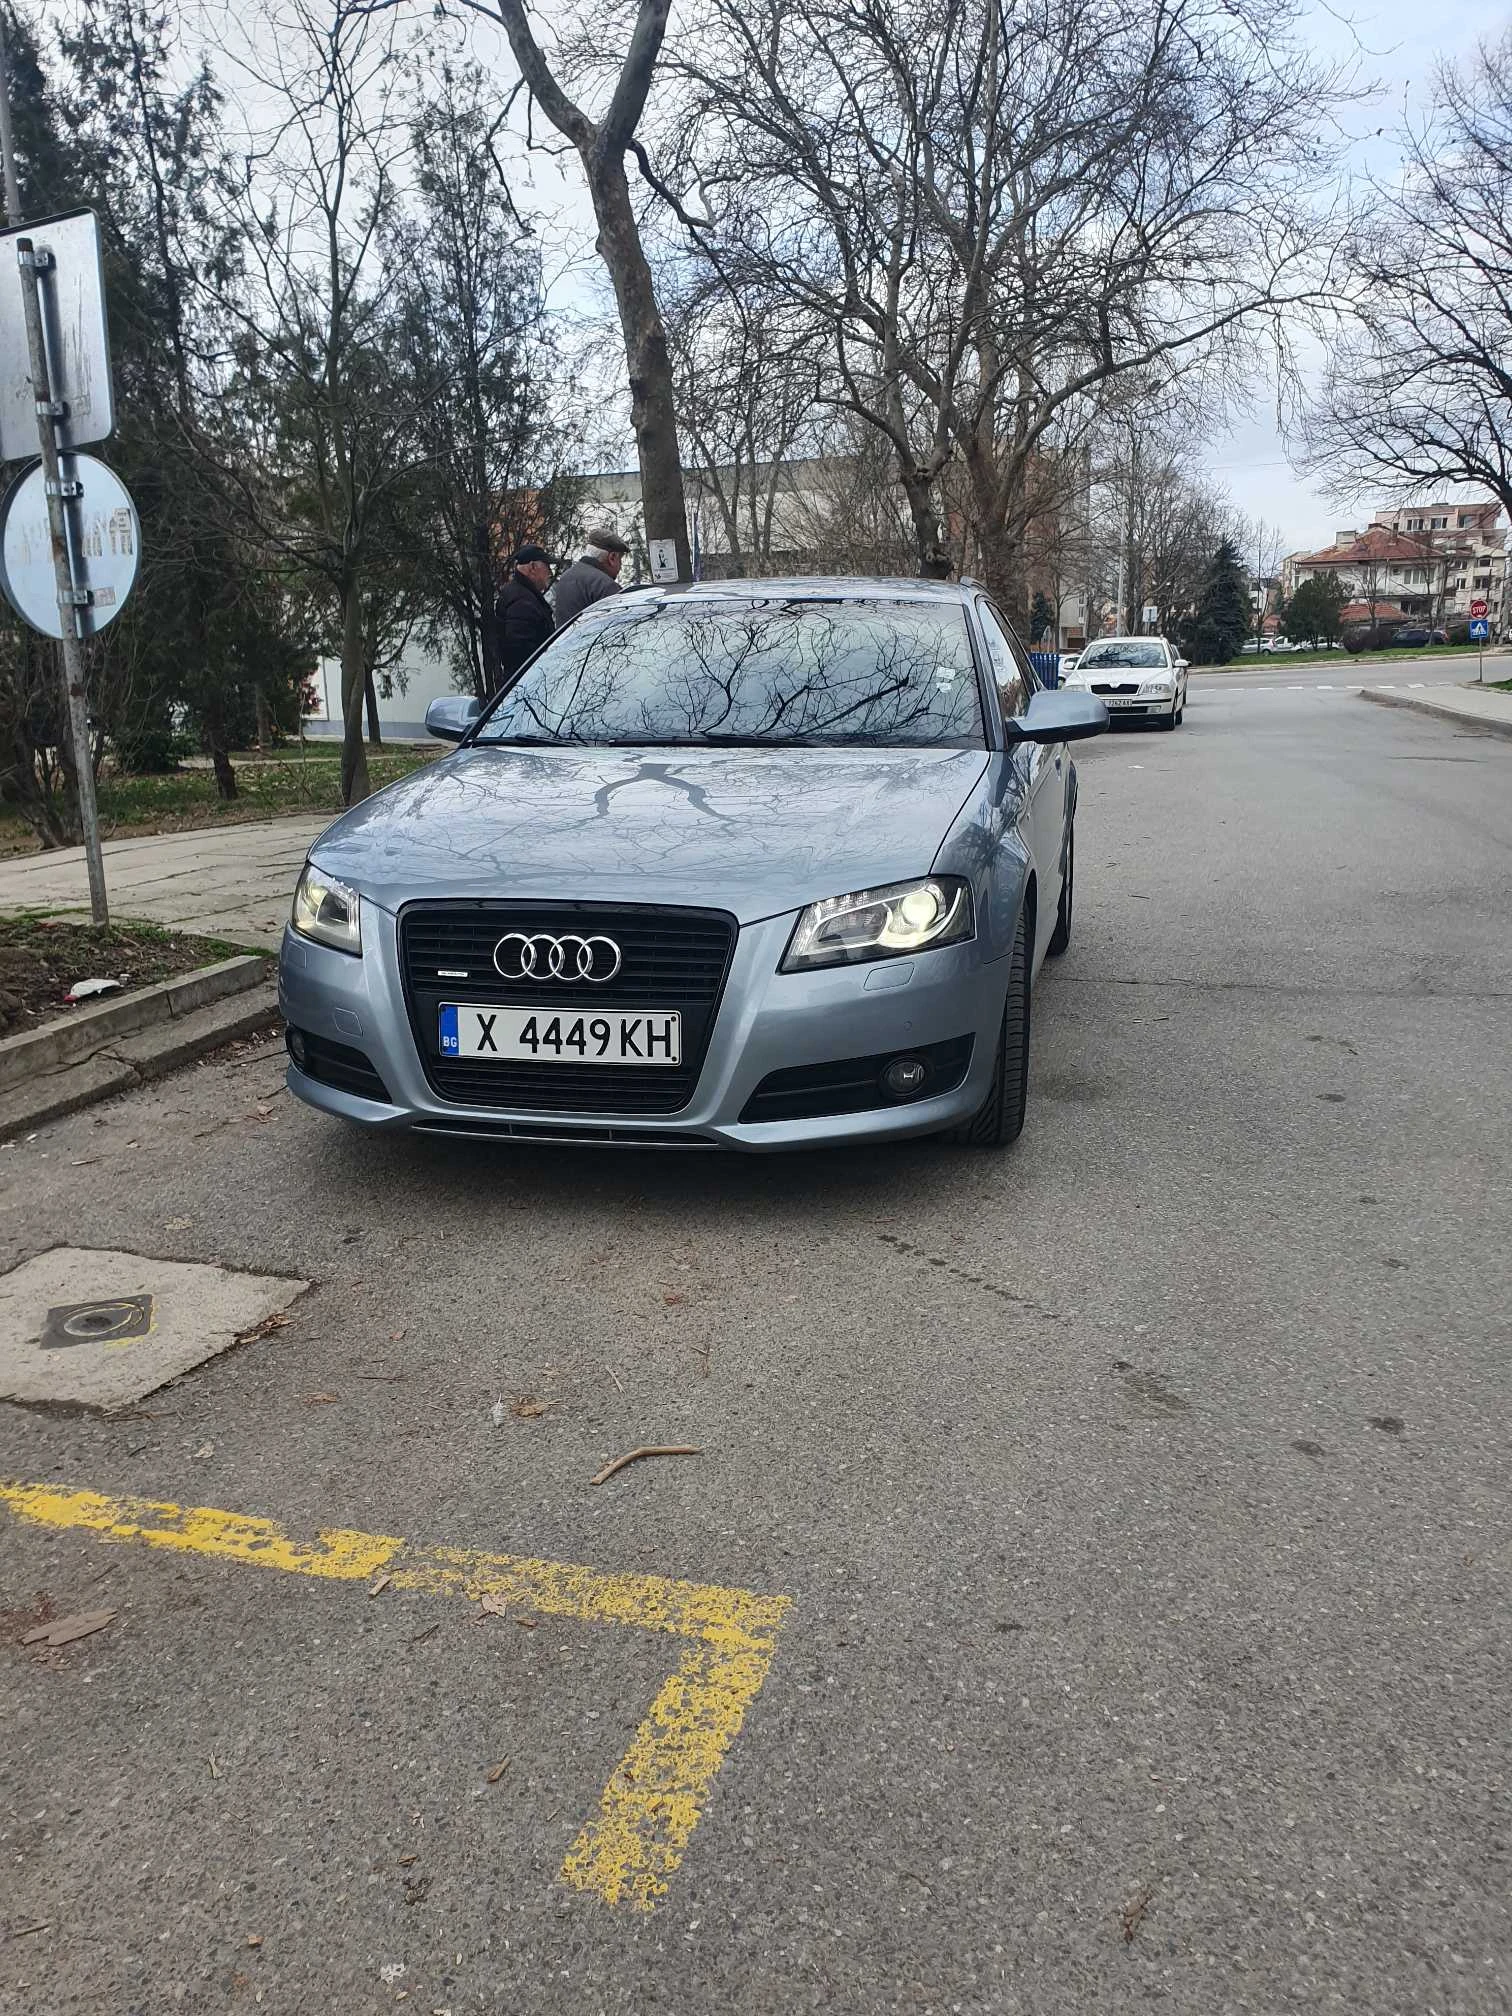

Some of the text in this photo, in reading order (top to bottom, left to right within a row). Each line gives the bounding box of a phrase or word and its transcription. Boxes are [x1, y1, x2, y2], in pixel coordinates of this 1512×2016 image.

[1472, 606, 1486, 614] STOP
[476, 1013, 672, 1058] X 4449 KH
[442, 1036, 458, 1048] BG
